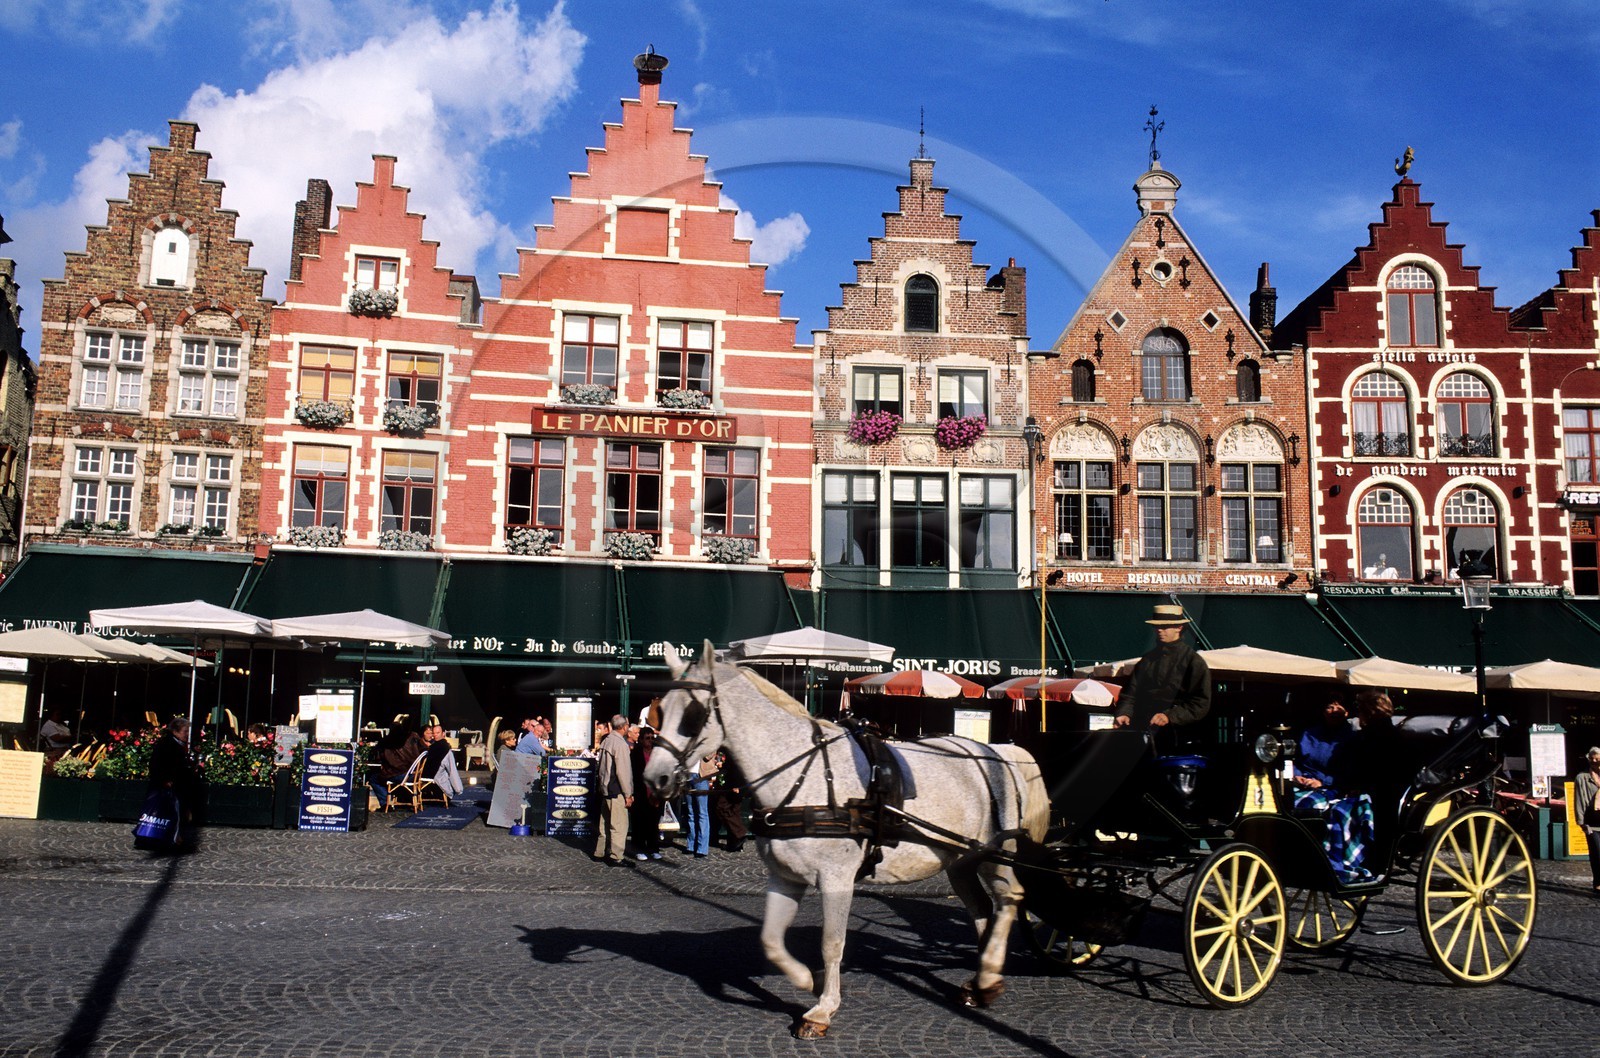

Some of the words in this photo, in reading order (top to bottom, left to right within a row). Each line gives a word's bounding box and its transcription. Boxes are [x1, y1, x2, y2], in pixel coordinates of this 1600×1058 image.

[1372, 351, 1416, 363] stella
[1427, 351, 1476, 363] artois
[542, 414, 572, 430] LE
[579, 413, 669, 435] PANIER
[677, 418, 732, 438] D'OR
[1335, 463, 1354, 477] de
[1371, 463, 1428, 479] gouden
[1447, 463, 1517, 477] meermin
[1066, 572, 1104, 584] HOTEL
[1127, 573, 1203, 585] RESTAURANT
[1225, 574, 1279, 586] CENTRAL
[1323, 586, 1385, 595] RESTAURANT
[1507, 588, 1559, 597] BRASSERIE
[473, 636, 505, 651] d'Or
[523, 638, 544, 653] In
[550, 639, 566, 653] de
[827, 663, 883, 673] Restaurant
[892, 658, 1001, 675] SINT-JORIS
[1010, 666, 1058, 676] Brasserie
[138, 813, 171, 826] DAMART
